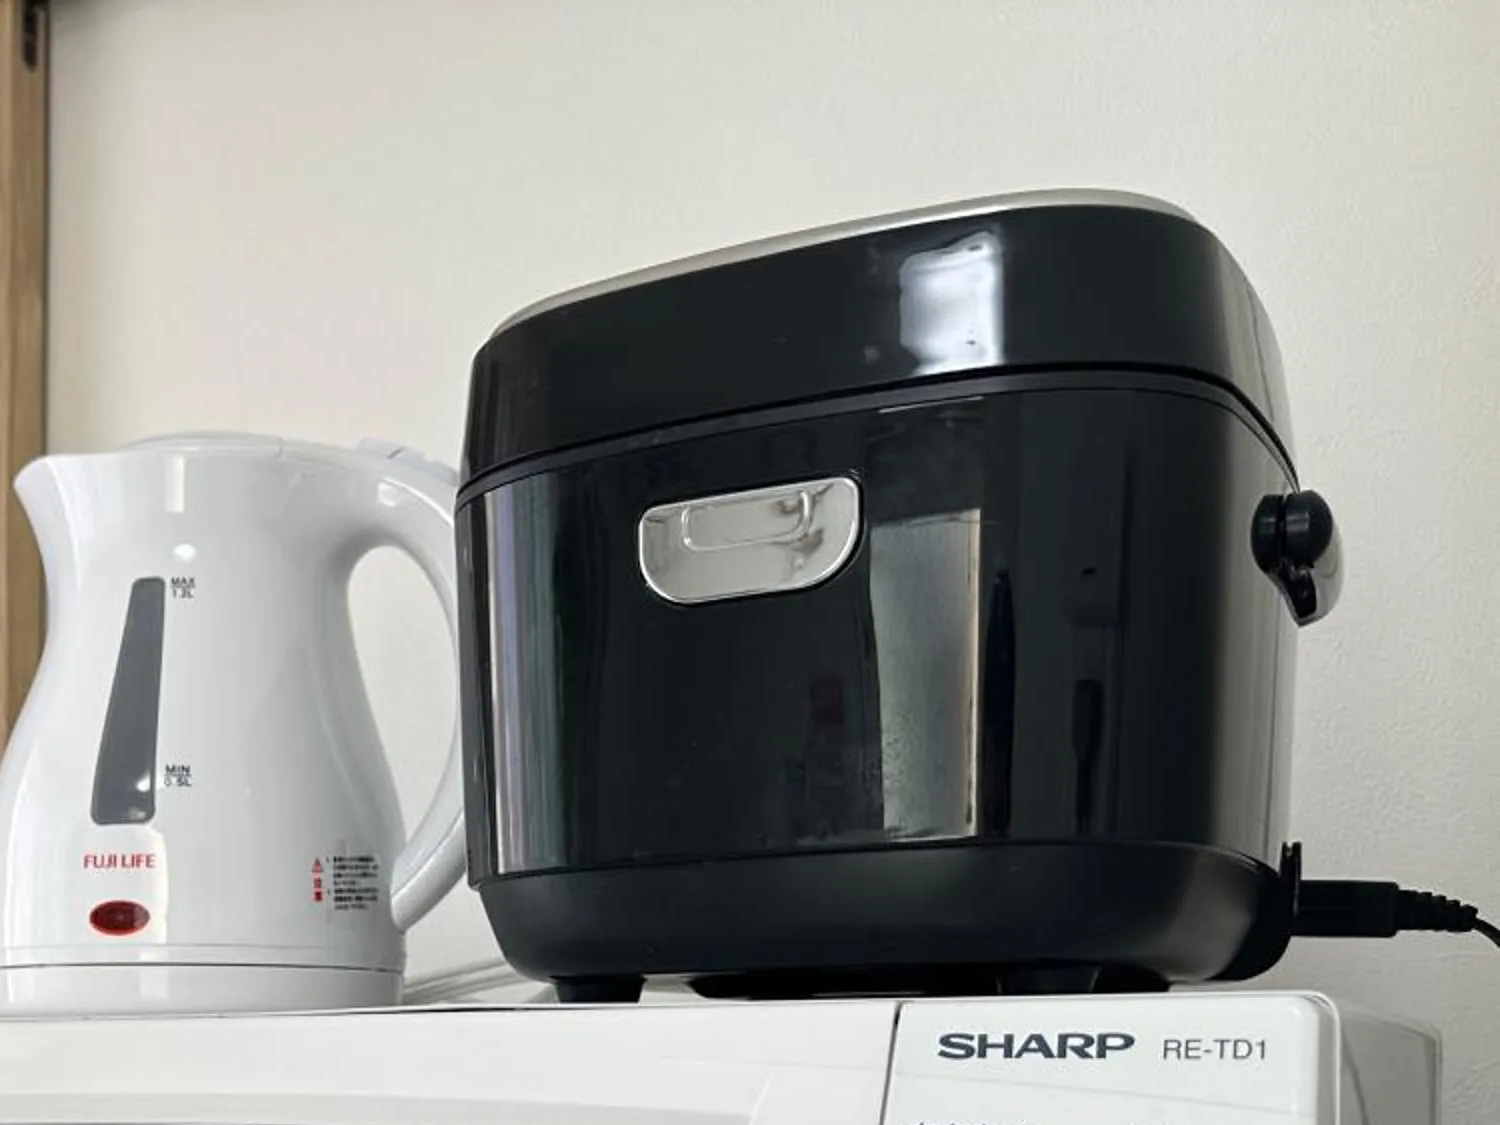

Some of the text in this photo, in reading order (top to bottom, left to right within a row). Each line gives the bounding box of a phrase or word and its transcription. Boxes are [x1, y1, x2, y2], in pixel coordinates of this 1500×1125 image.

[165, 764, 190, 773] MIN
[83, 853, 156, 869] FUJI LIFE
[938, 1033, 1268, 1061] SHARP RE-TD1
